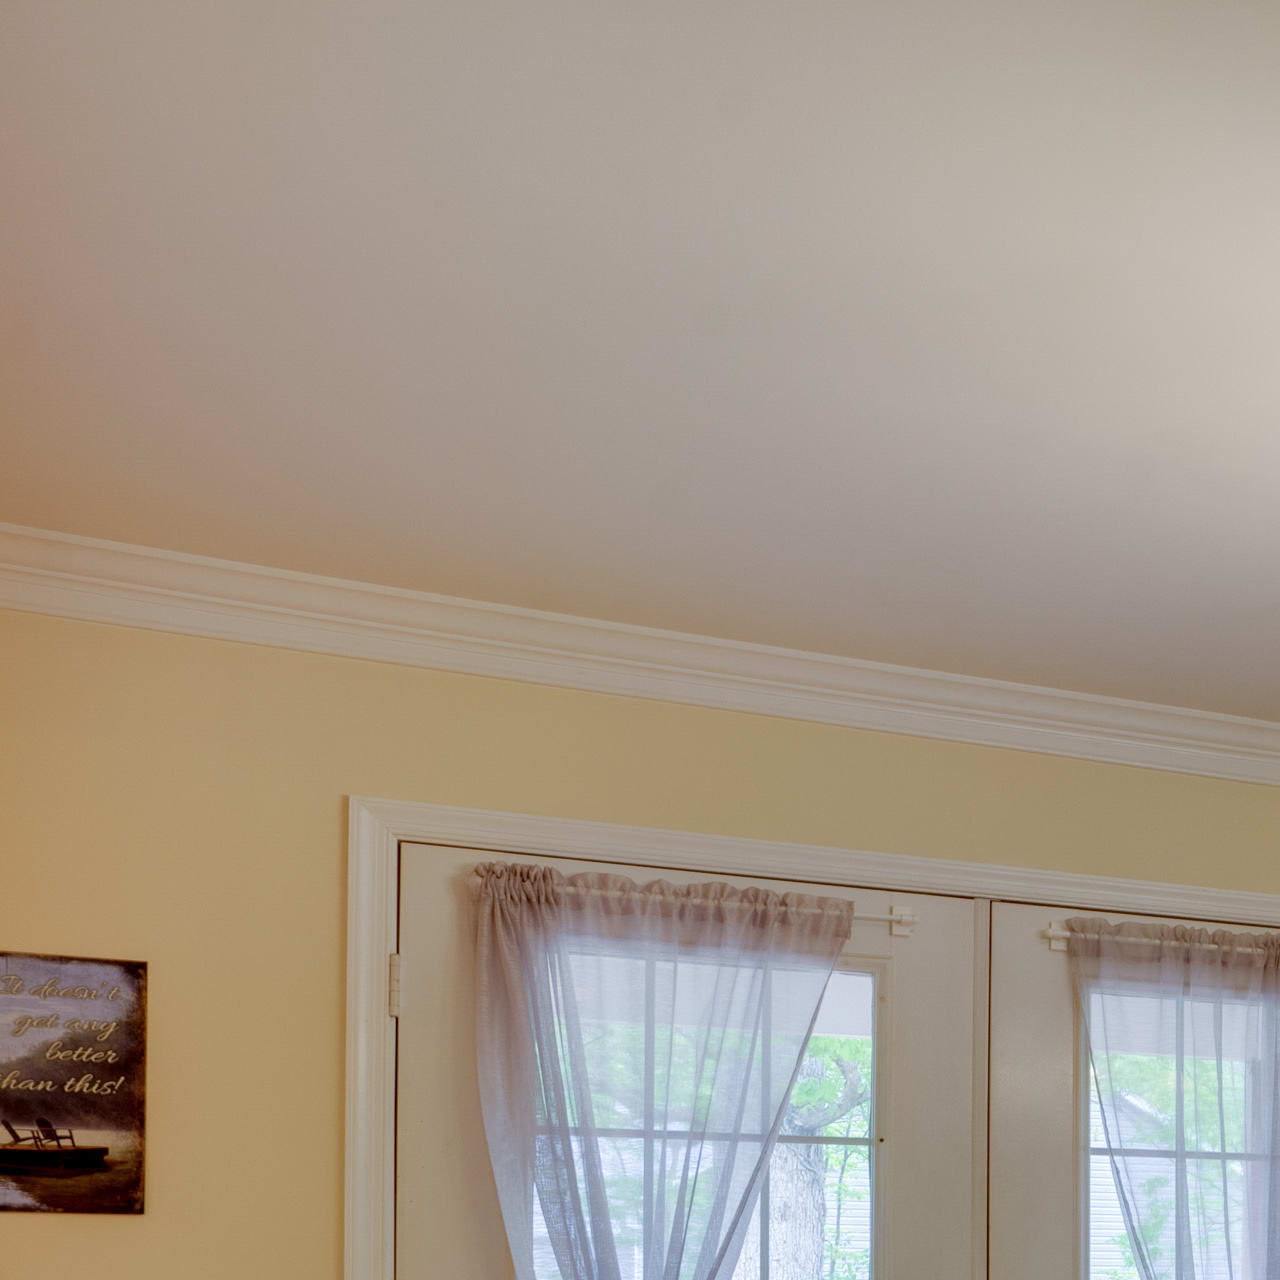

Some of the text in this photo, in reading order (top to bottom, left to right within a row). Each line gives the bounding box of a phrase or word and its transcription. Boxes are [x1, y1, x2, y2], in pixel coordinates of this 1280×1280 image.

[30, 978, 121, 1001] doesn't
[12, 1014, 120, 1041] get any
[46, 1041, 119, 1064] better
[0, 1070, 125, 1095] han this!
